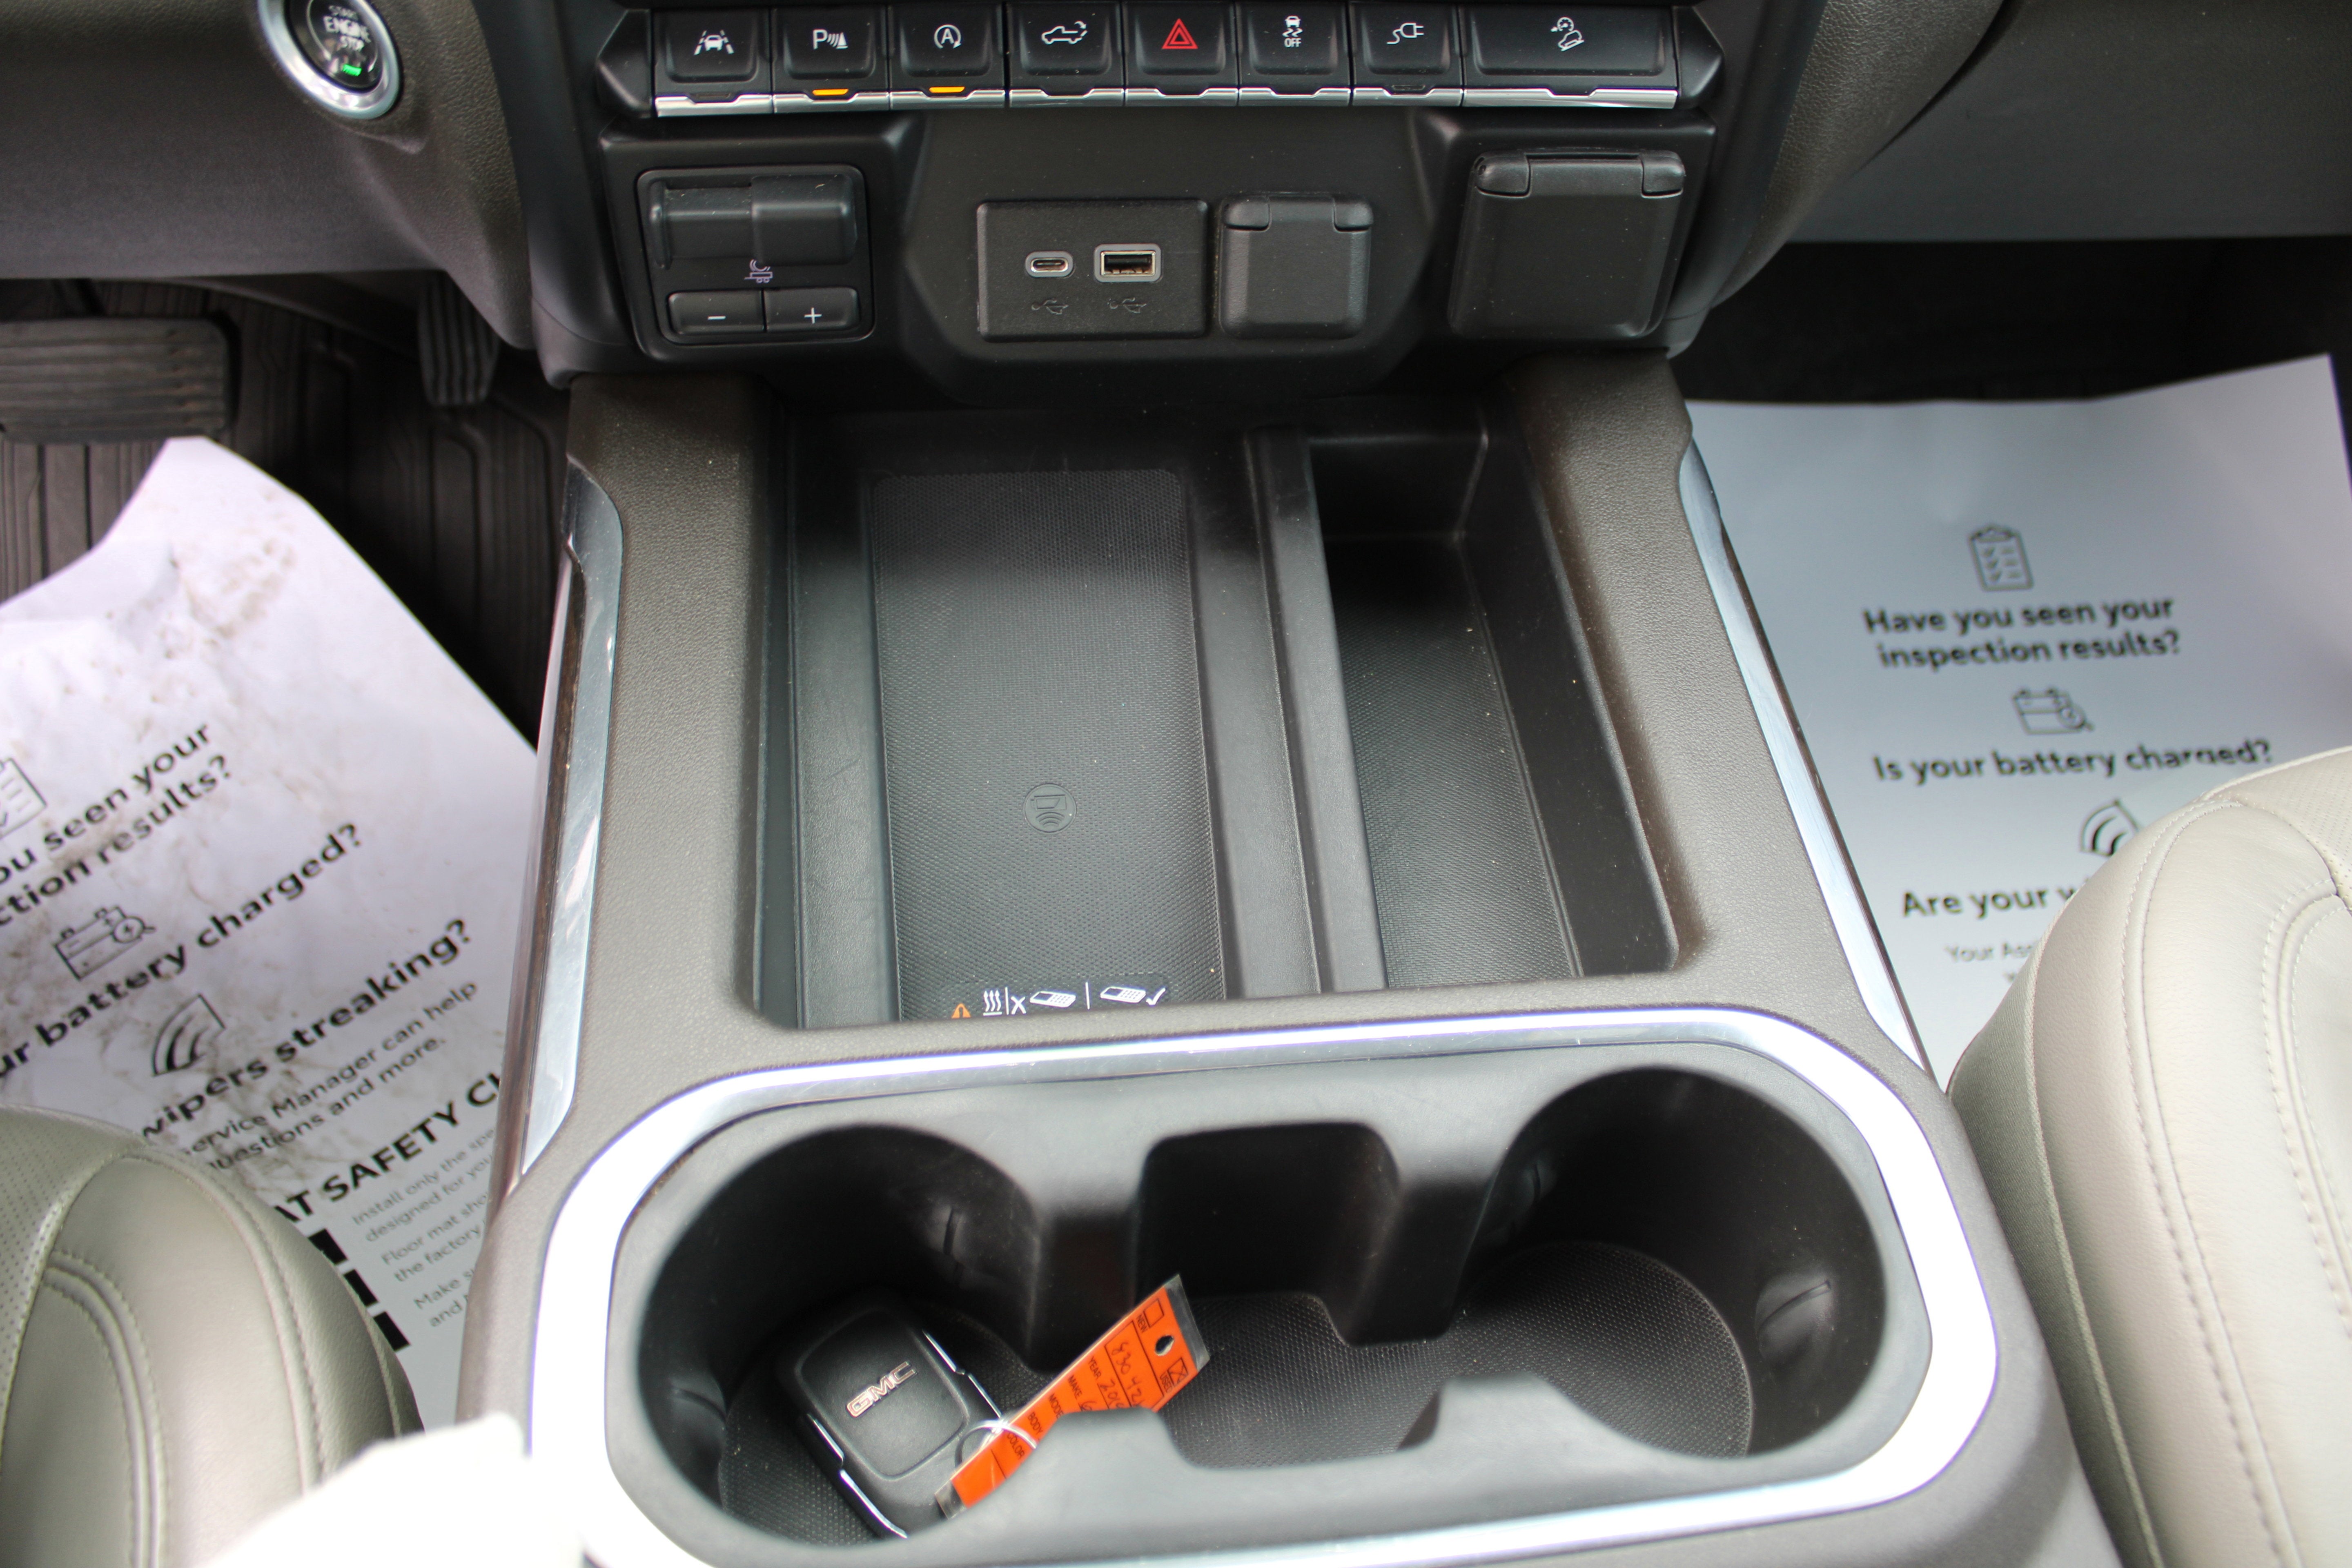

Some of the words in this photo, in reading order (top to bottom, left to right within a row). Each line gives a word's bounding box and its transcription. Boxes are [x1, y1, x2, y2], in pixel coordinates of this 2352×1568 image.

[323, 15, 371, 43] ENGINE
[340, 35, 365, 52] STOP
[1284, 37, 1302, 48] OFF
[1863, 607, 1947, 635] Have
[1953, 608, 2013, 637] you
[2021, 603, 2096, 626] seen
[2102, 597, 2174, 628] your
[1877, 637, 2053, 673] inspection
[2058, 627, 2180, 662] results?
[1873, 755, 1904, 781] Is
[1910, 755, 1986, 786] your
[1990, 750, 2117, 779] battery
[2125, 737, 2273, 770] charged?
[43, 788, 129, 852] seen
[131, 724, 211, 795] your
[98, 754, 232, 864] results?
[1902, 890, 1963, 918] Are
[1969, 888, 2049, 920] your
[34, 942, 188, 1047] battery
[196, 822, 362, 949] charged?
[1944, 944, 1994, 962] Your
[274, 918, 471, 1063] streaking?
[185, 1116, 269, 1155] ervice
[271, 1047, 378, 1118] Manager
[381, 1019, 425, 1051] can
[423, 982, 477, 1020] help
[329, 1077, 376, 1116] and
[378, 1037, 446, 1082] more.
[323, 1100, 459, 1202] SAFETY
[352, 1191, 405, 1226] Install
[405, 1170, 440, 1195] only
[440, 1151, 467, 1172] the
[366, 1191, 443, 1242] designed
[442, 1176, 465, 1196] for
[381, 1236, 424, 1265] Floor
[427, 1215, 460, 1239] mat
[394, 1262, 425, 1282] the
[425, 1225, 481, 1264] factory
[414, 1279, 461, 1310] Make
[429, 1299, 463, 1327] and
[1136, 1314, 1148, 1334] NEW
[846, 1361, 918, 1418] GMC
[1067, 1374, 1082, 1399] MAKE
[1088, 1356, 1101, 1379] YEAR
[1027, 1411, 1043, 1434] BODY
[1007, 1432, 1025, 1461] COLOR
